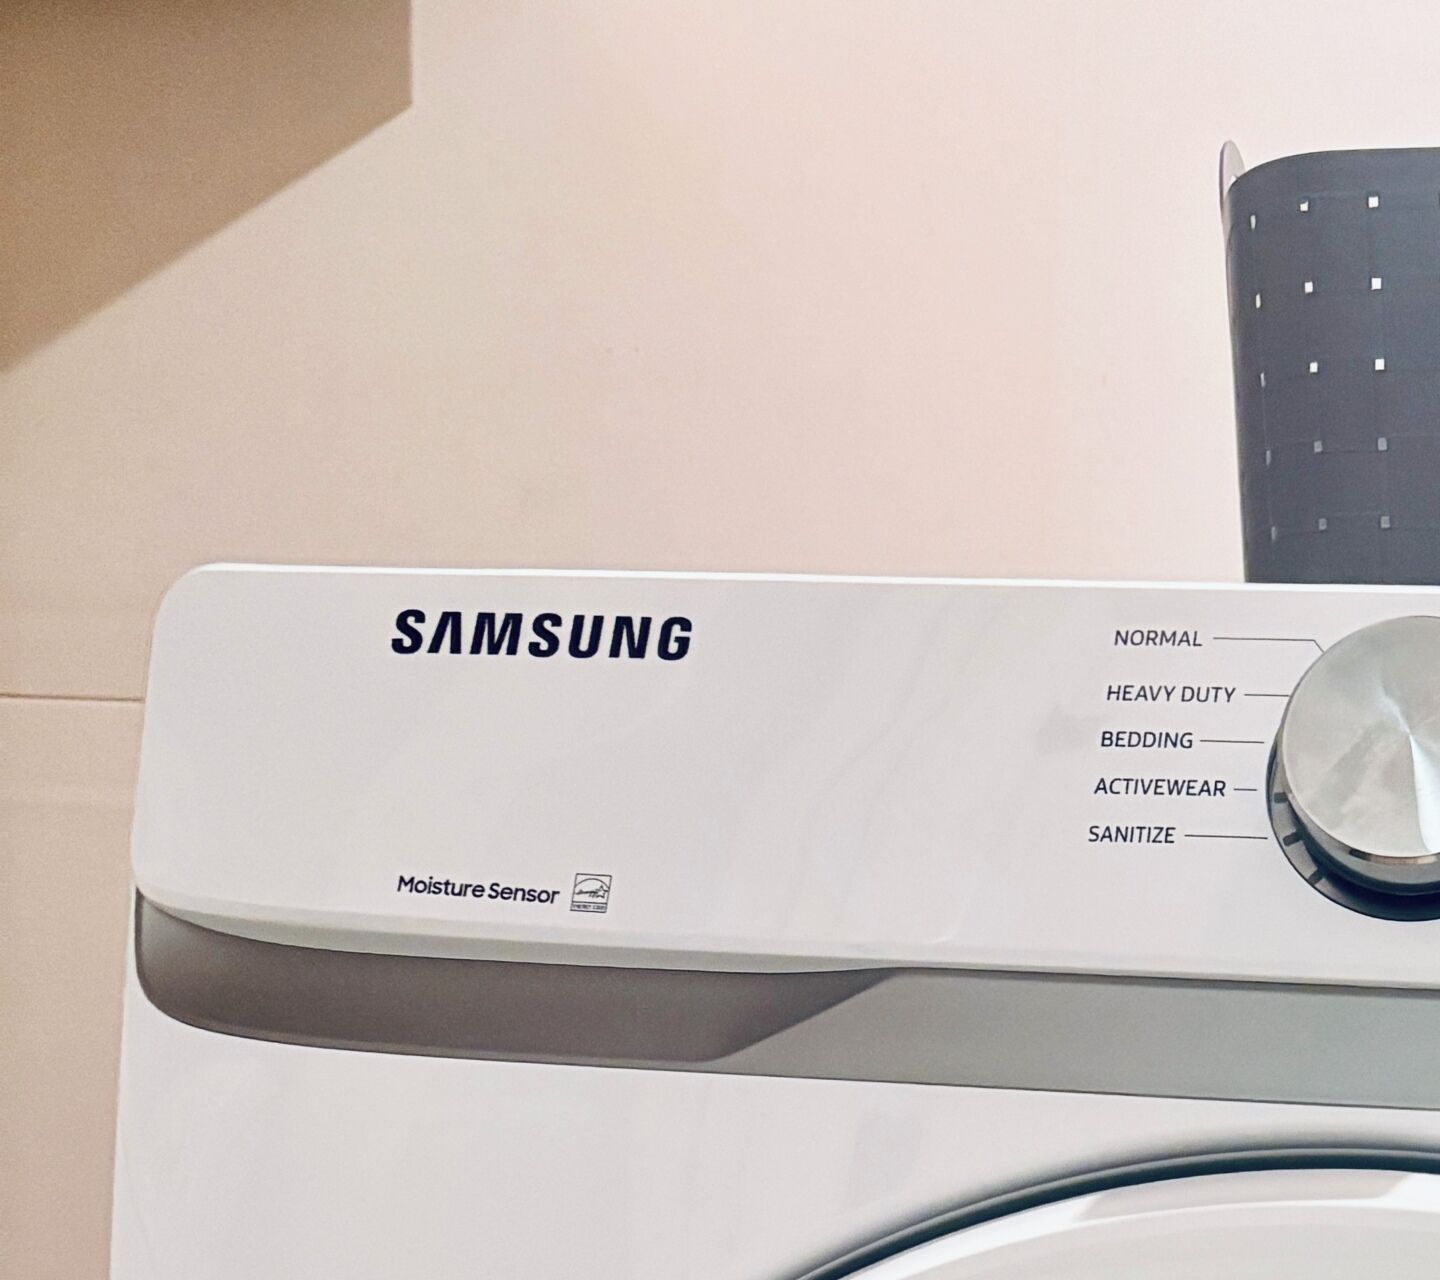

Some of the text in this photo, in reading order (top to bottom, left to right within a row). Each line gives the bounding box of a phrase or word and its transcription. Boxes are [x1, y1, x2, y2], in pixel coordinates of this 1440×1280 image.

[390, 608, 693, 662] SAMSUNG
[1113, 629, 1203, 647] NORMAL
[1106, 684, 1237, 703] HEAVY DUTY
[1100, 730, 1193, 749] BEDDING
[1093, 777, 1227, 798] ACTIVEWEAR
[1087, 825, 1177, 844] SANITIZE
[396, 874, 486, 899] Moisture
[487, 882, 561, 905] Sensor
